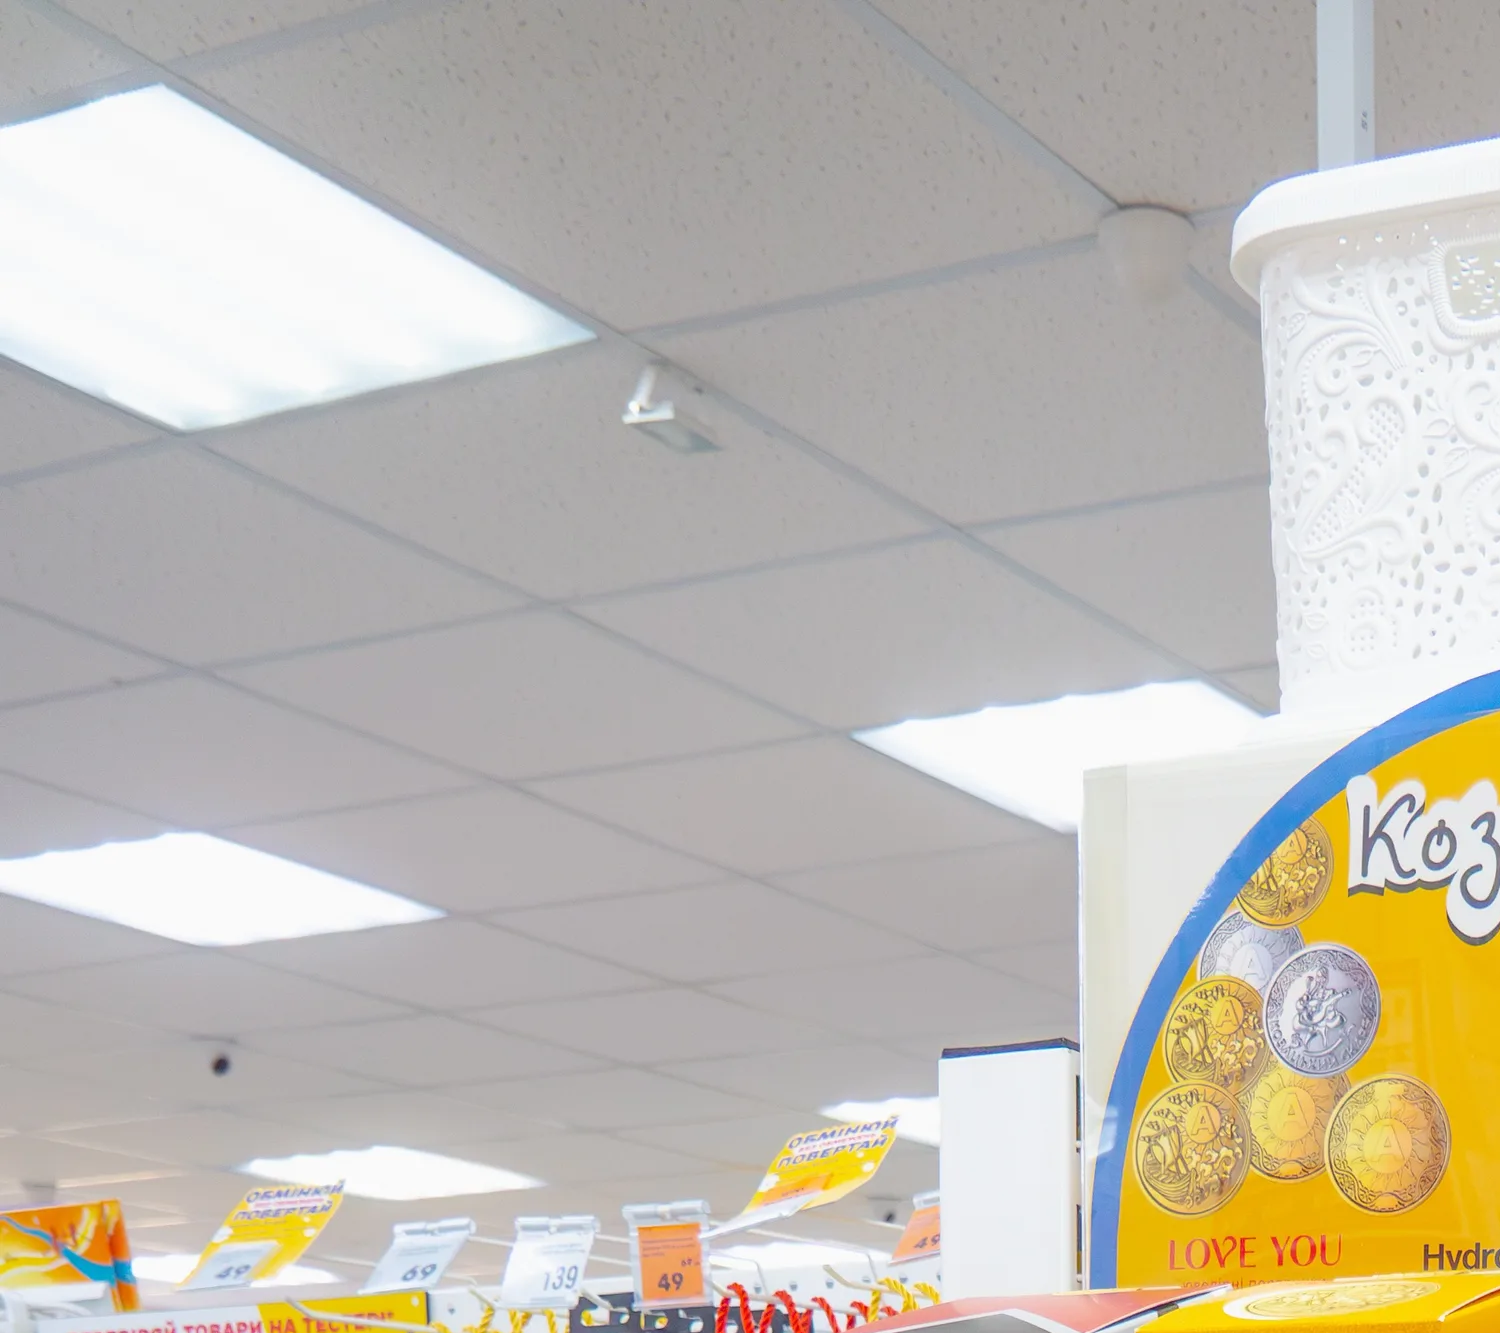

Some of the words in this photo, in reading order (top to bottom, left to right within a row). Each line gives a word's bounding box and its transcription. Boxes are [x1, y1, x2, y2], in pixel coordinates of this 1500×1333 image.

[777, 1134, 889, 1169] ПОВЕРТАЙ
[1169, 1237, 1256, 1271] LOVE
[1270, 1234, 1342, 1267] YOU
[401, 1263, 438, 1283] 69
[542, 1265, 579, 1291] 139
[658, 1272, 684, 1292] 49
